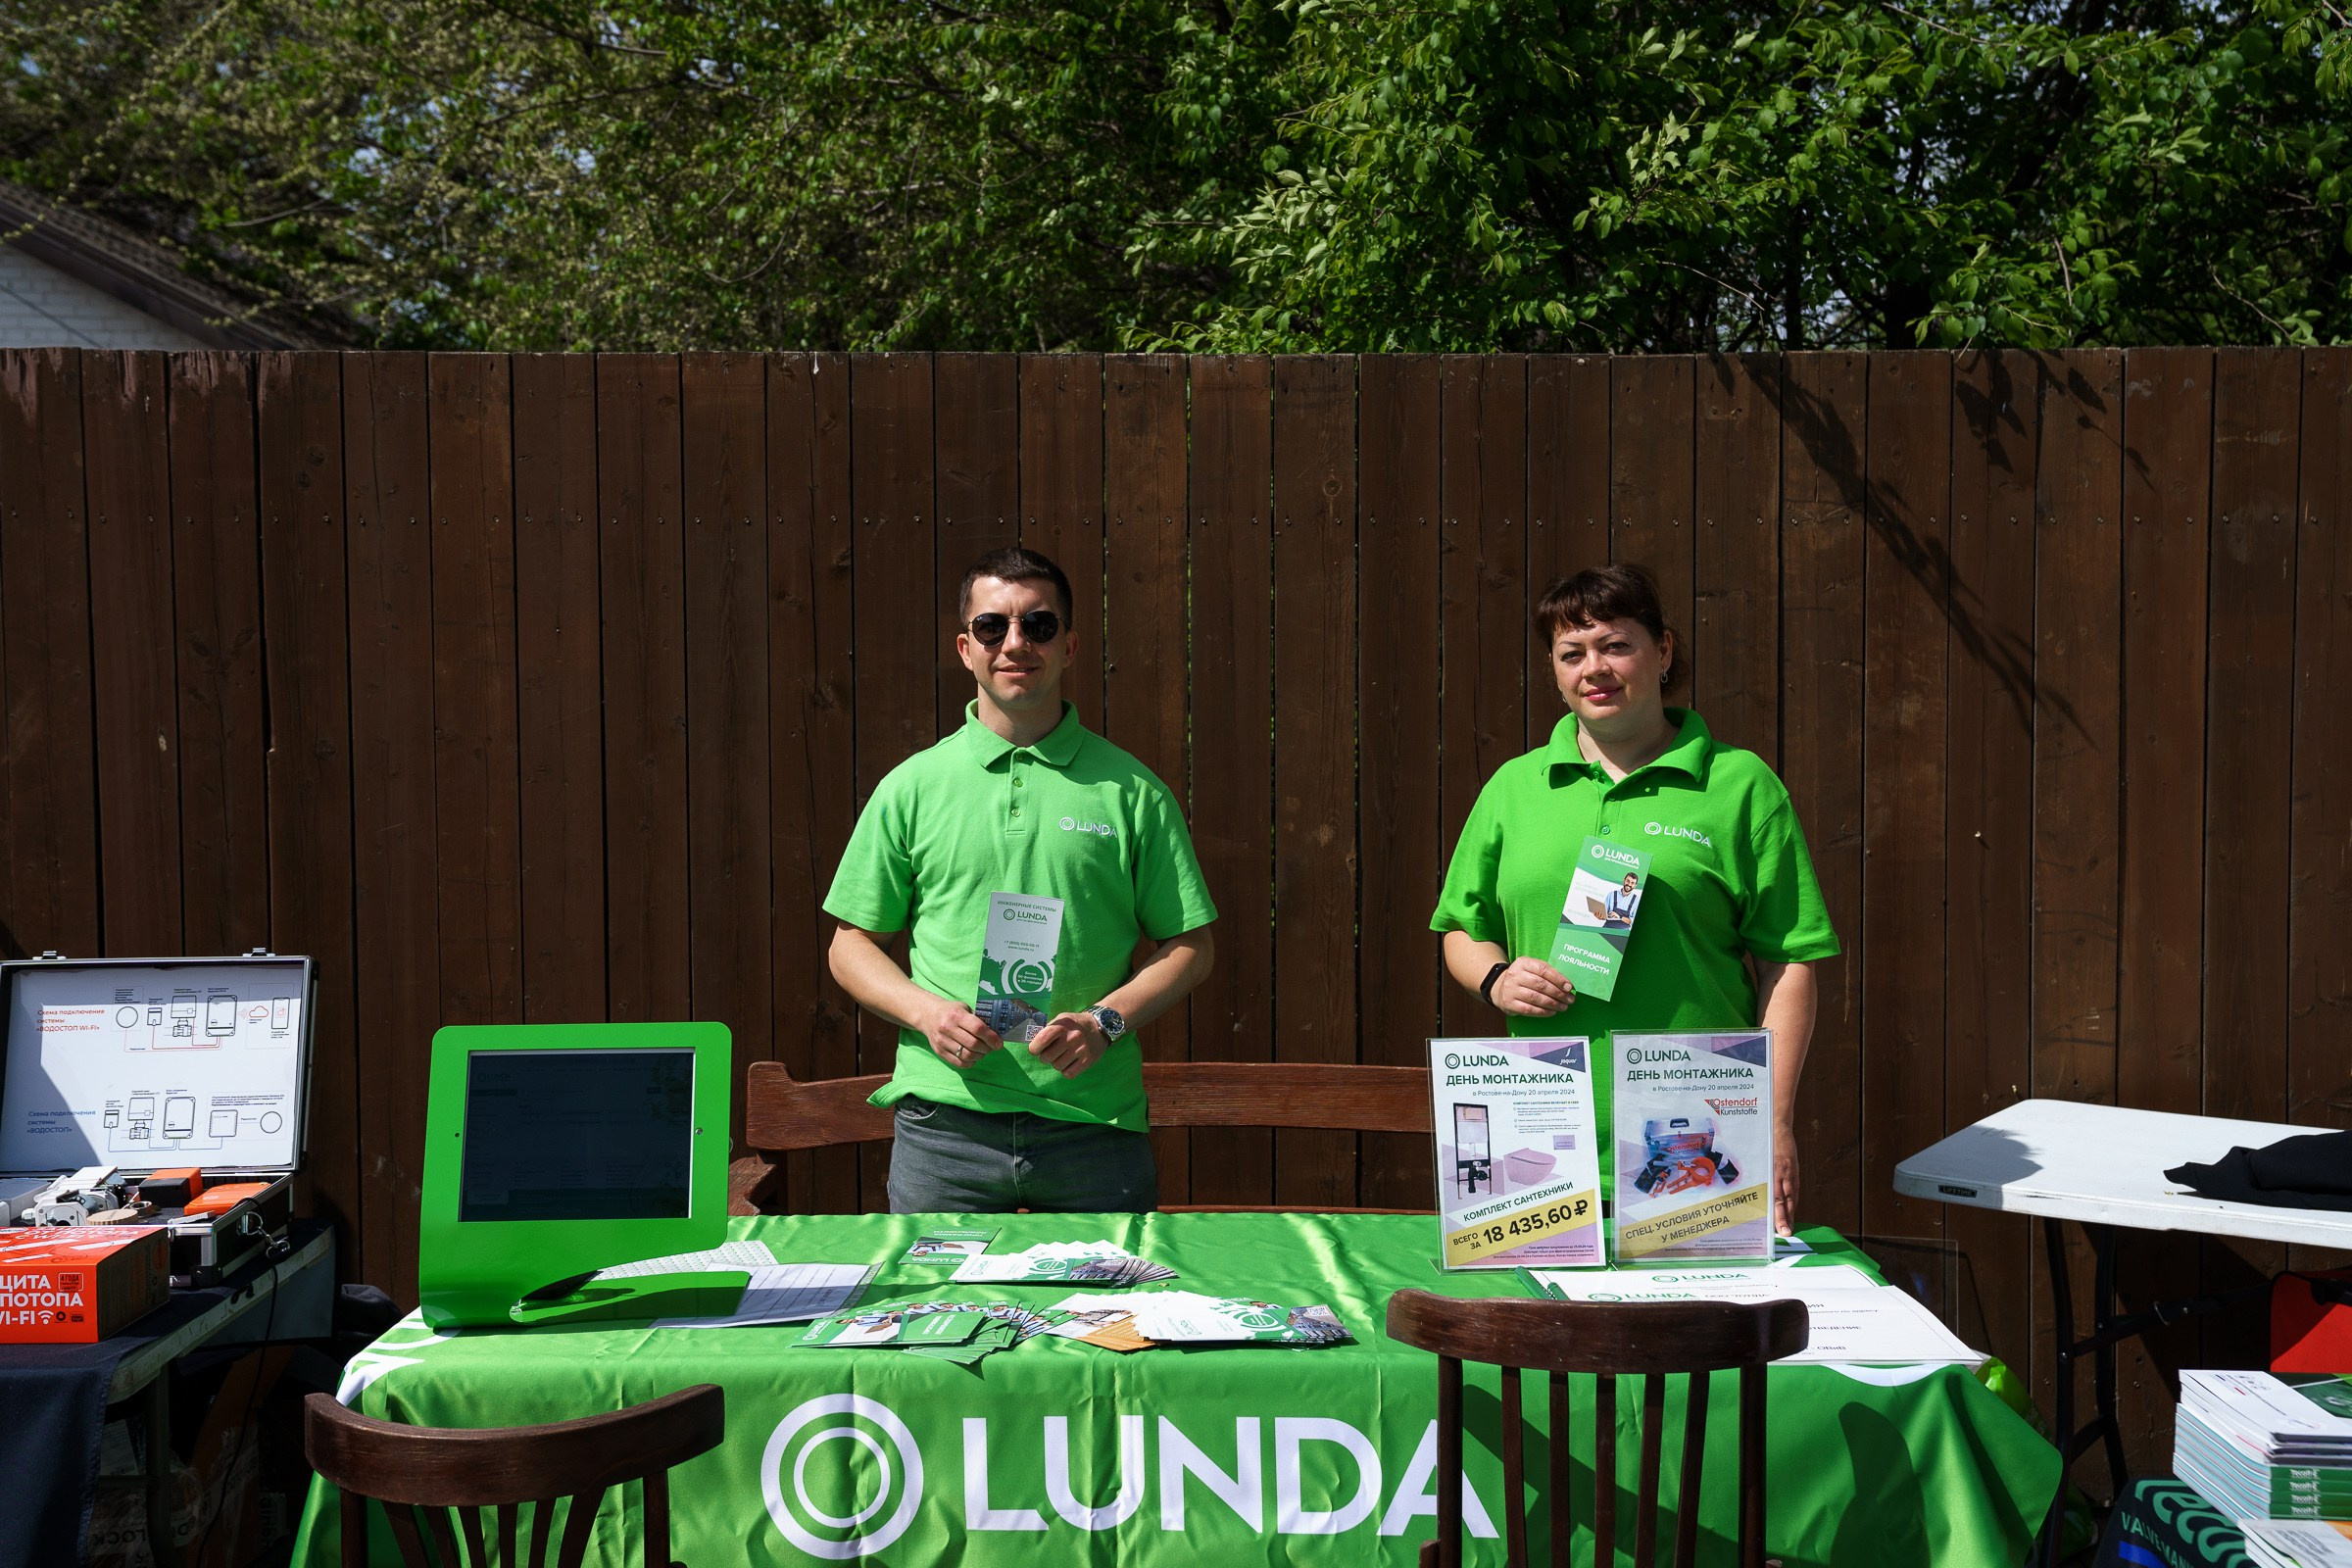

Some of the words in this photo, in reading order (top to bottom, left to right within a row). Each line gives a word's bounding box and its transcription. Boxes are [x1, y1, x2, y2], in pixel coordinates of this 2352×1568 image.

[1077, 820, 1117, 838] LUNDA
[1664, 826, 1712, 848] LUNDA
[1605, 848, 1640, 866] LUNDA
[1017, 910, 1048, 921] LUNDA
[1564, 944, 1610, 964] ПРОГРАММА
[1558, 954, 1610, 975] ЛОЯЛЬНОСТИ
[1462, 1054, 1509, 1067] LUNDA
[1644, 1050, 1690, 1062] LUNDA
[1446, 1075, 1480, 1086] ДЕНЬ
[1483, 1073, 1574, 1085] МОНТАЖНИКА
[1627, 1069, 1660, 1082] ДЕНЬ
[1664, 1067, 1754, 1080] МОНТАЖНИКА
[1714, 1097, 1758, 1107] Ostendorf
[1463, 1200, 1511, 1222] КОМПЛЕКТ
[1513, 1182, 1574, 1207] САНТЕХНИКИ
[1625, 1225, 1654, 1240] СПЕЦ.
[1655, 1209, 1701, 1234] УСЛОВИЯ
[1703, 1192, 1758, 1216] УТОЧНЯЙТЕ
[1484, 1226, 1504, 1245] 18
[1670, 1215, 1730, 1241] МЕНЕДЖЕРА
[1452, 1233, 1478, 1246] ВСЕГО
[0, 1293, 83, 1307] ПОТОПА
[962, 1414, 1500, 1539] LUNDA
